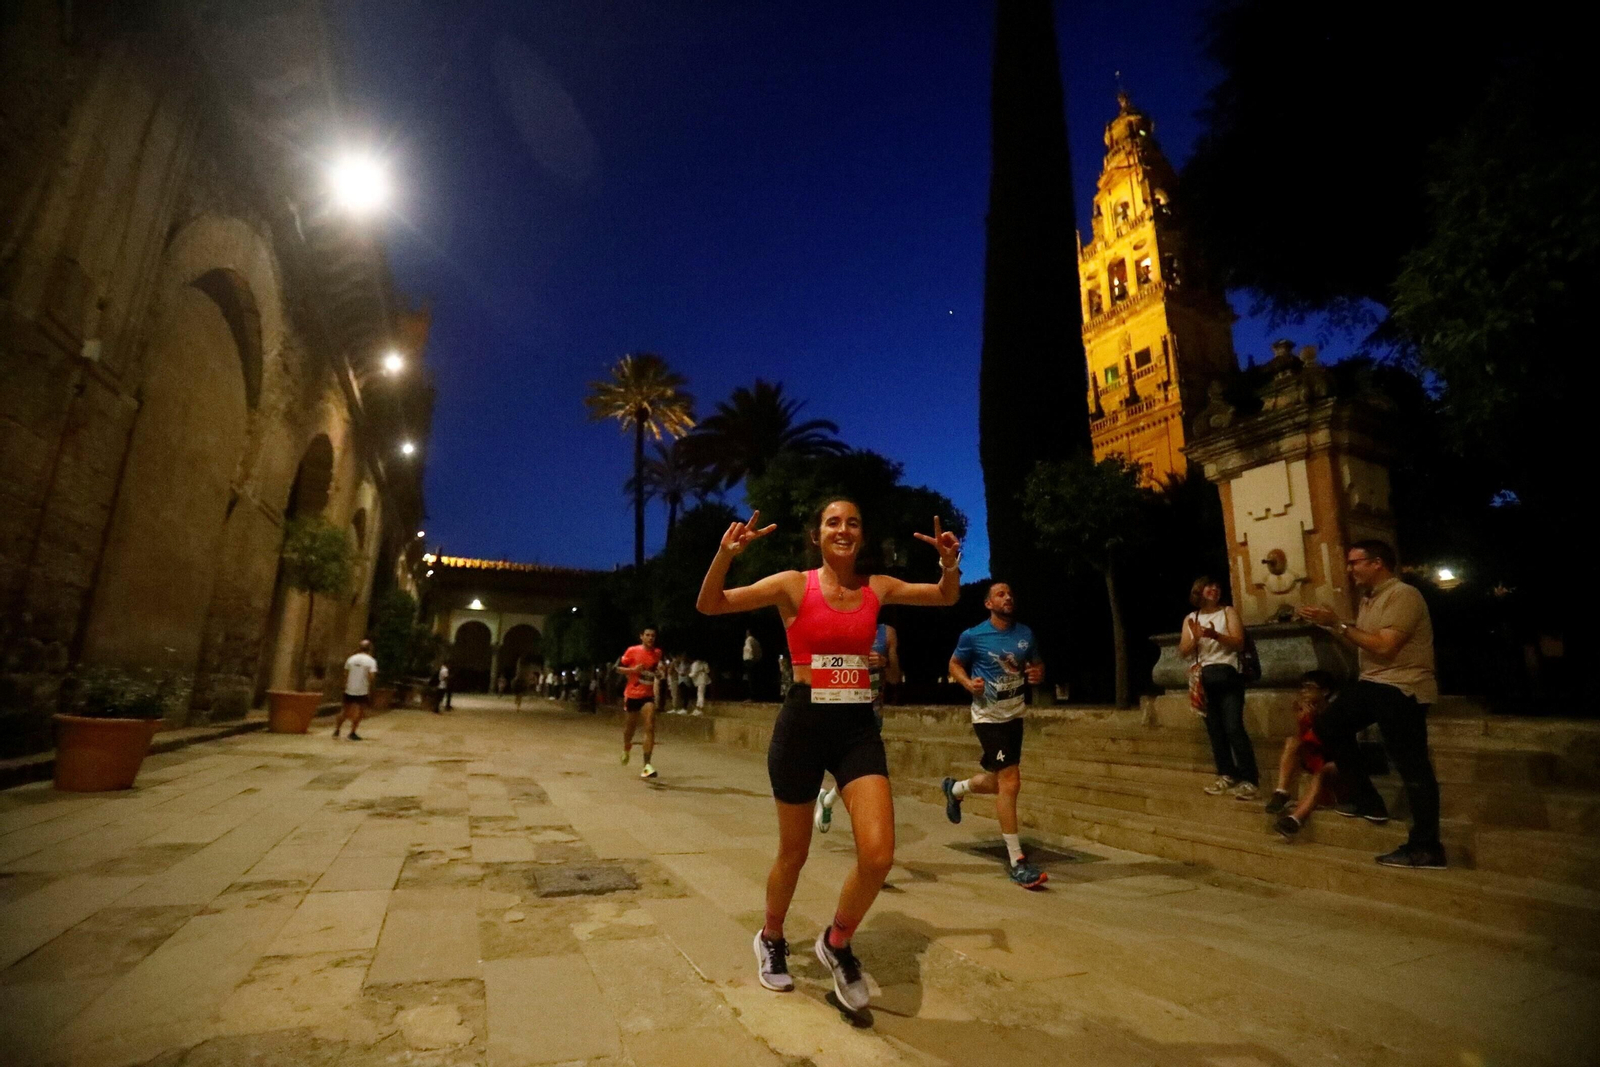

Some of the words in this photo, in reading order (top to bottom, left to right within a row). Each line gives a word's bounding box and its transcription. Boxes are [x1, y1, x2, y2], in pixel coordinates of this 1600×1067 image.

[831, 657, 843, 667] 20
[830, 669, 859, 684] 300
[996, 749, 1006, 762] 4
